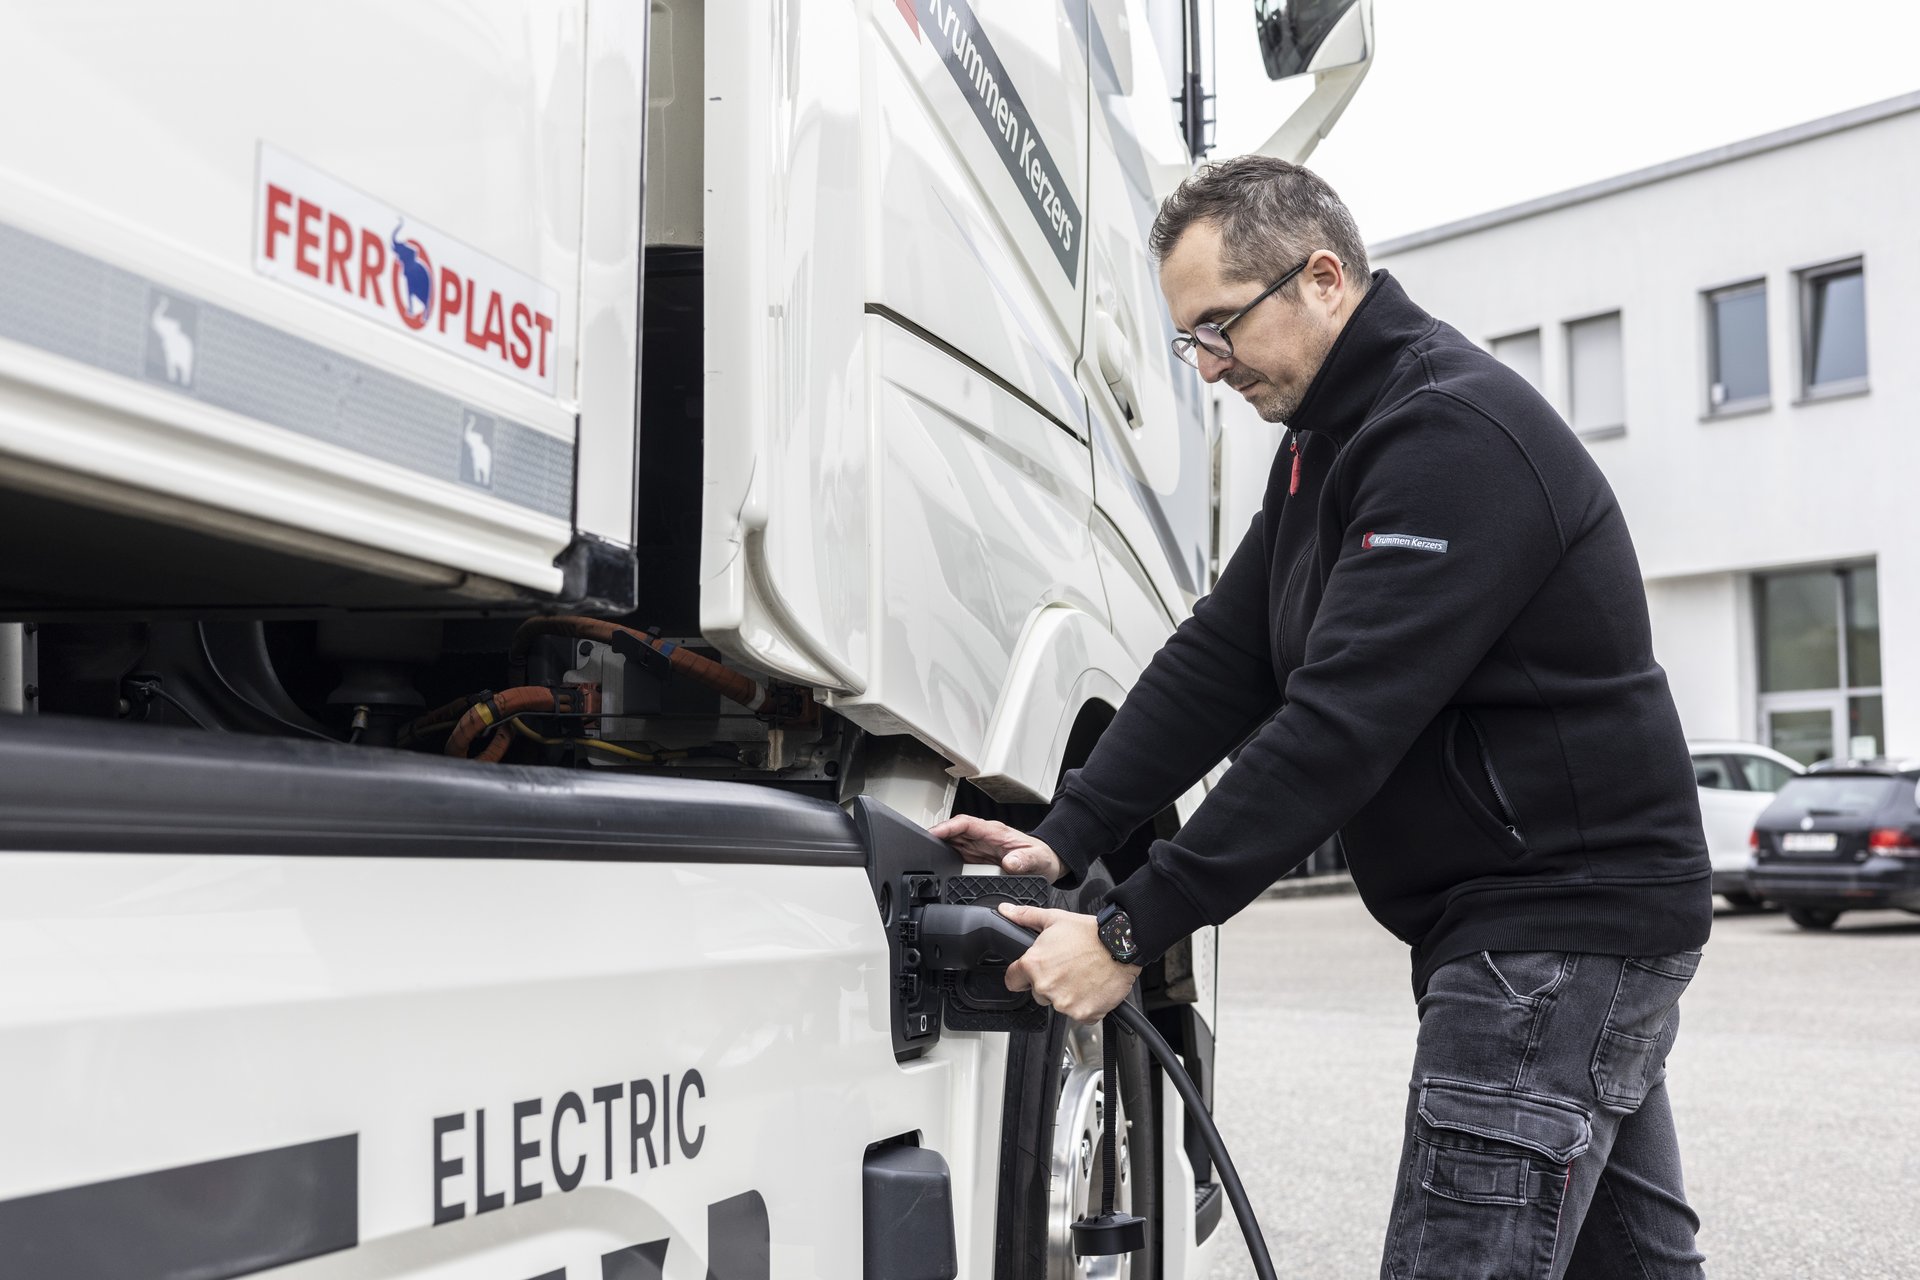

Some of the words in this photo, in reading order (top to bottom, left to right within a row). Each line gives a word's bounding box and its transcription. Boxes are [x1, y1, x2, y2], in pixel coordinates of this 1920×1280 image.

[1019, 127, 1074, 251] Kerzers
[264, 182, 554, 378] FERROPLAST
[1374, 536, 1410, 545] Krummen
[1411, 537, 1443, 550] Kerzers
[433, 1068, 706, 1227] ELECTRIC
